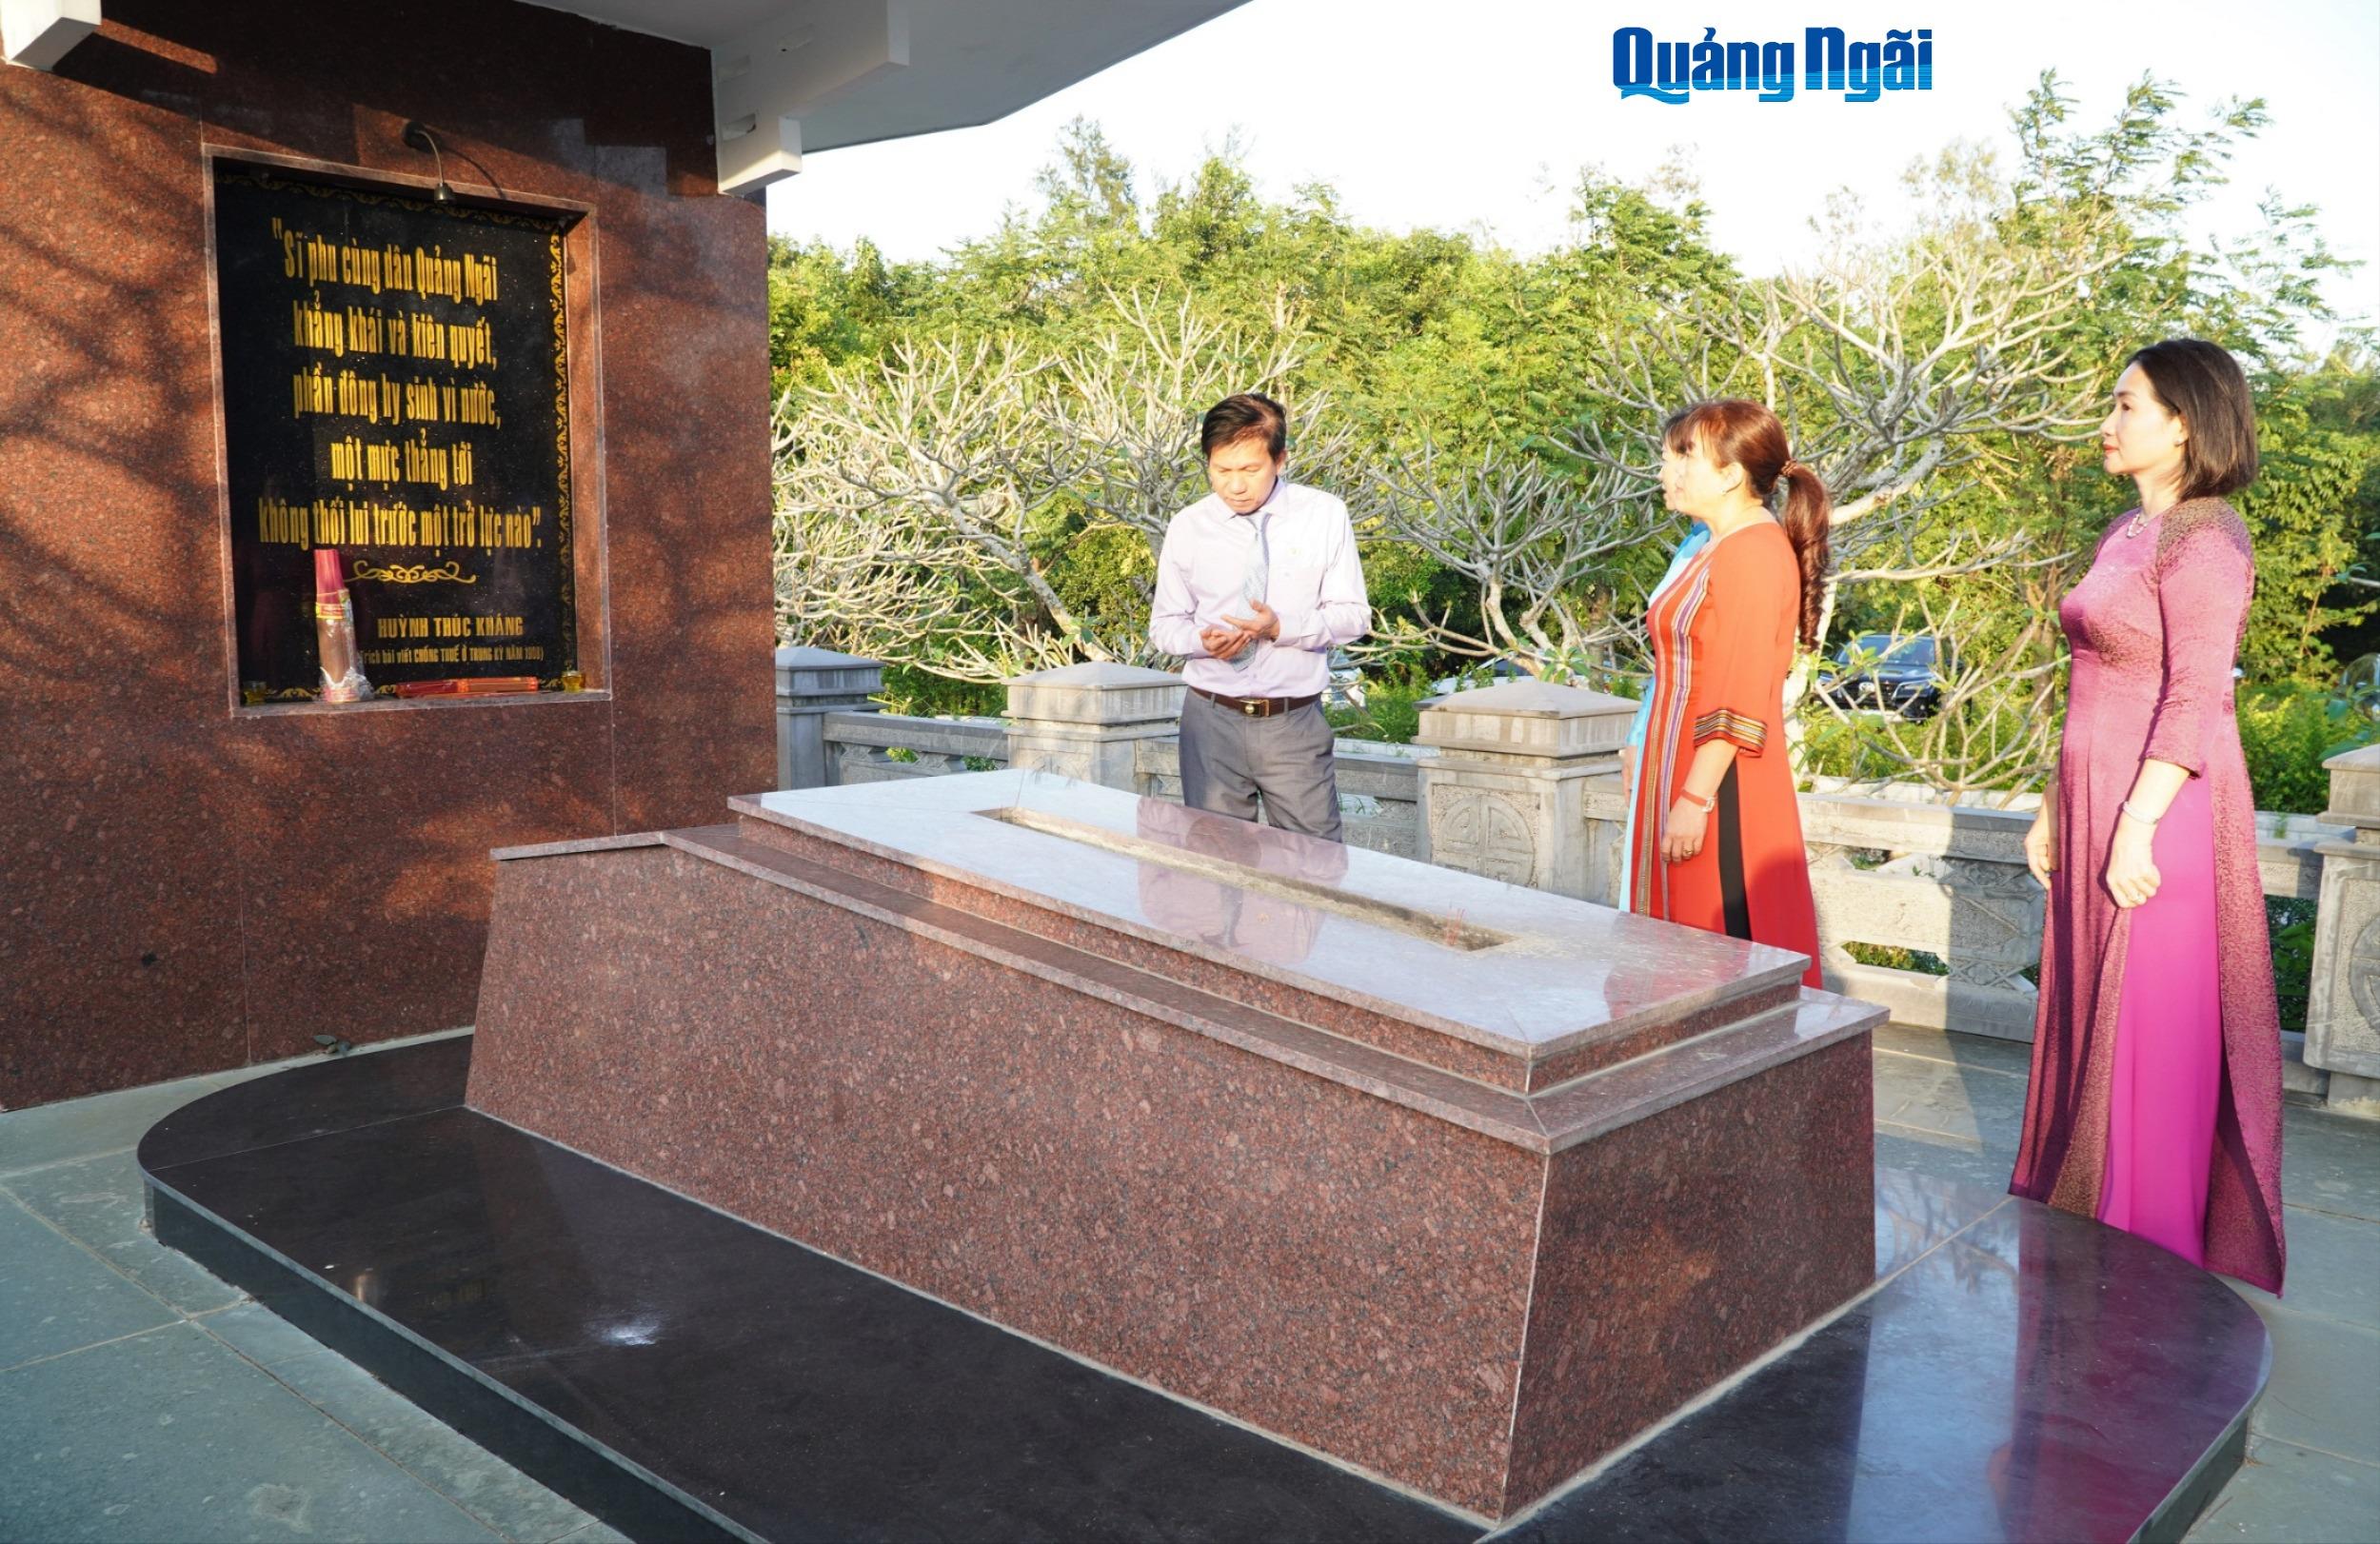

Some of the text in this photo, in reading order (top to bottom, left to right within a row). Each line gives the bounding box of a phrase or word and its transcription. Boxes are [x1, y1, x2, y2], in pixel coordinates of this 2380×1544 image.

[307, 234, 337, 287] phu
[343, 237, 381, 294] cùng
[384, 244, 411, 290] dân
[416, 245, 461, 304] Quảng
[465, 253, 497, 306] Ngãi
[293, 290, 497, 370] khẳng khái và kiên quyết,
[293, 362, 501, 429] phần đông hy sinh vì nước,
[330, 427, 472, 491] một mực thẳng tới
[258, 497, 308, 550] không
[313, 496, 346, 544] thối
[349, 500, 368, 544] lui
[373, 501, 416, 546] trước
[421, 504, 449, 557] một
[452, 500, 475, 547] trở
[480, 505, 502, 556] lực
[378, 613, 524, 638] HUỲNH THÚC KHÁNG
